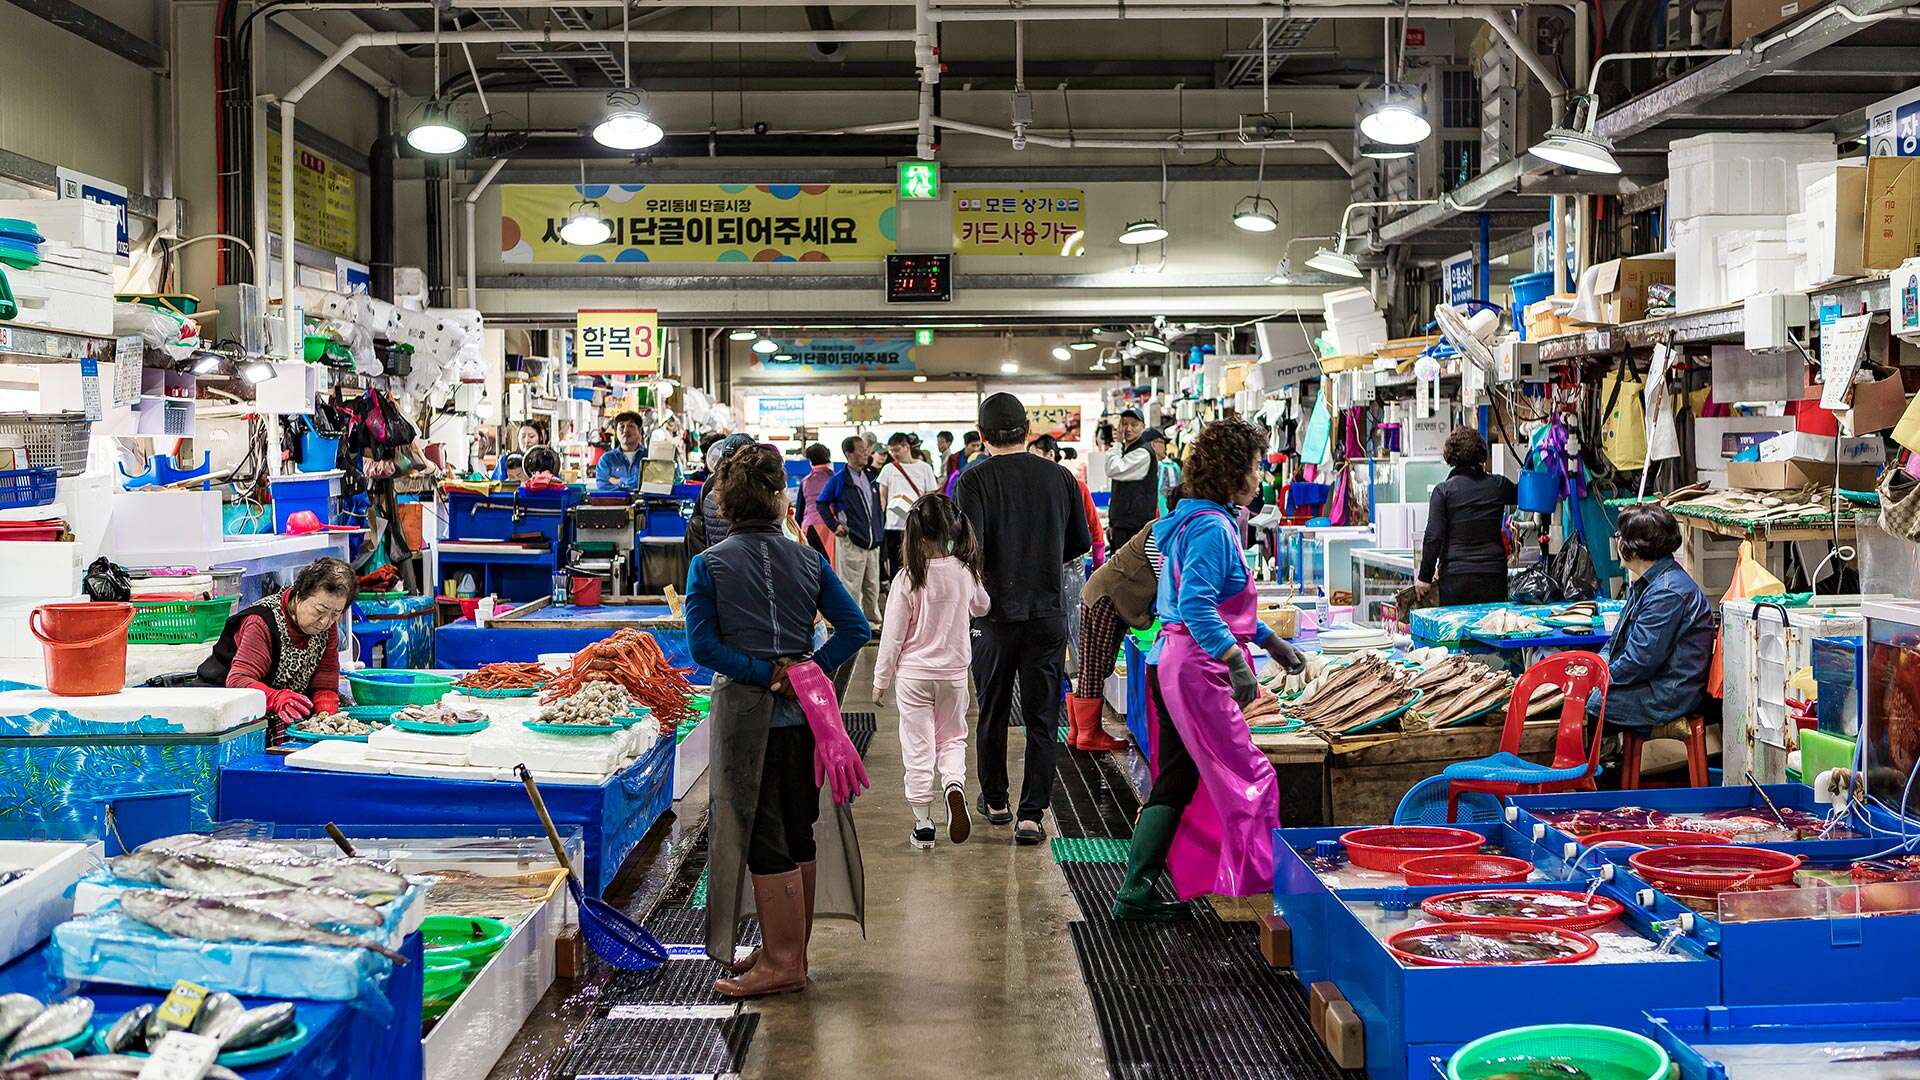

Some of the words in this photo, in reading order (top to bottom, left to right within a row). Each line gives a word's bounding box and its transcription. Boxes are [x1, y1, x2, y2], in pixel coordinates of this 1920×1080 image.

[646, 199, 697, 213] 우리동네
[700, 199, 751, 213] 단골시장
[985, 198, 1017, 213] 모든
[1021, 198, 1053, 214] 상가
[630, 216, 712, 246] 단골이
[717, 216, 858, 247] 되어주세요
